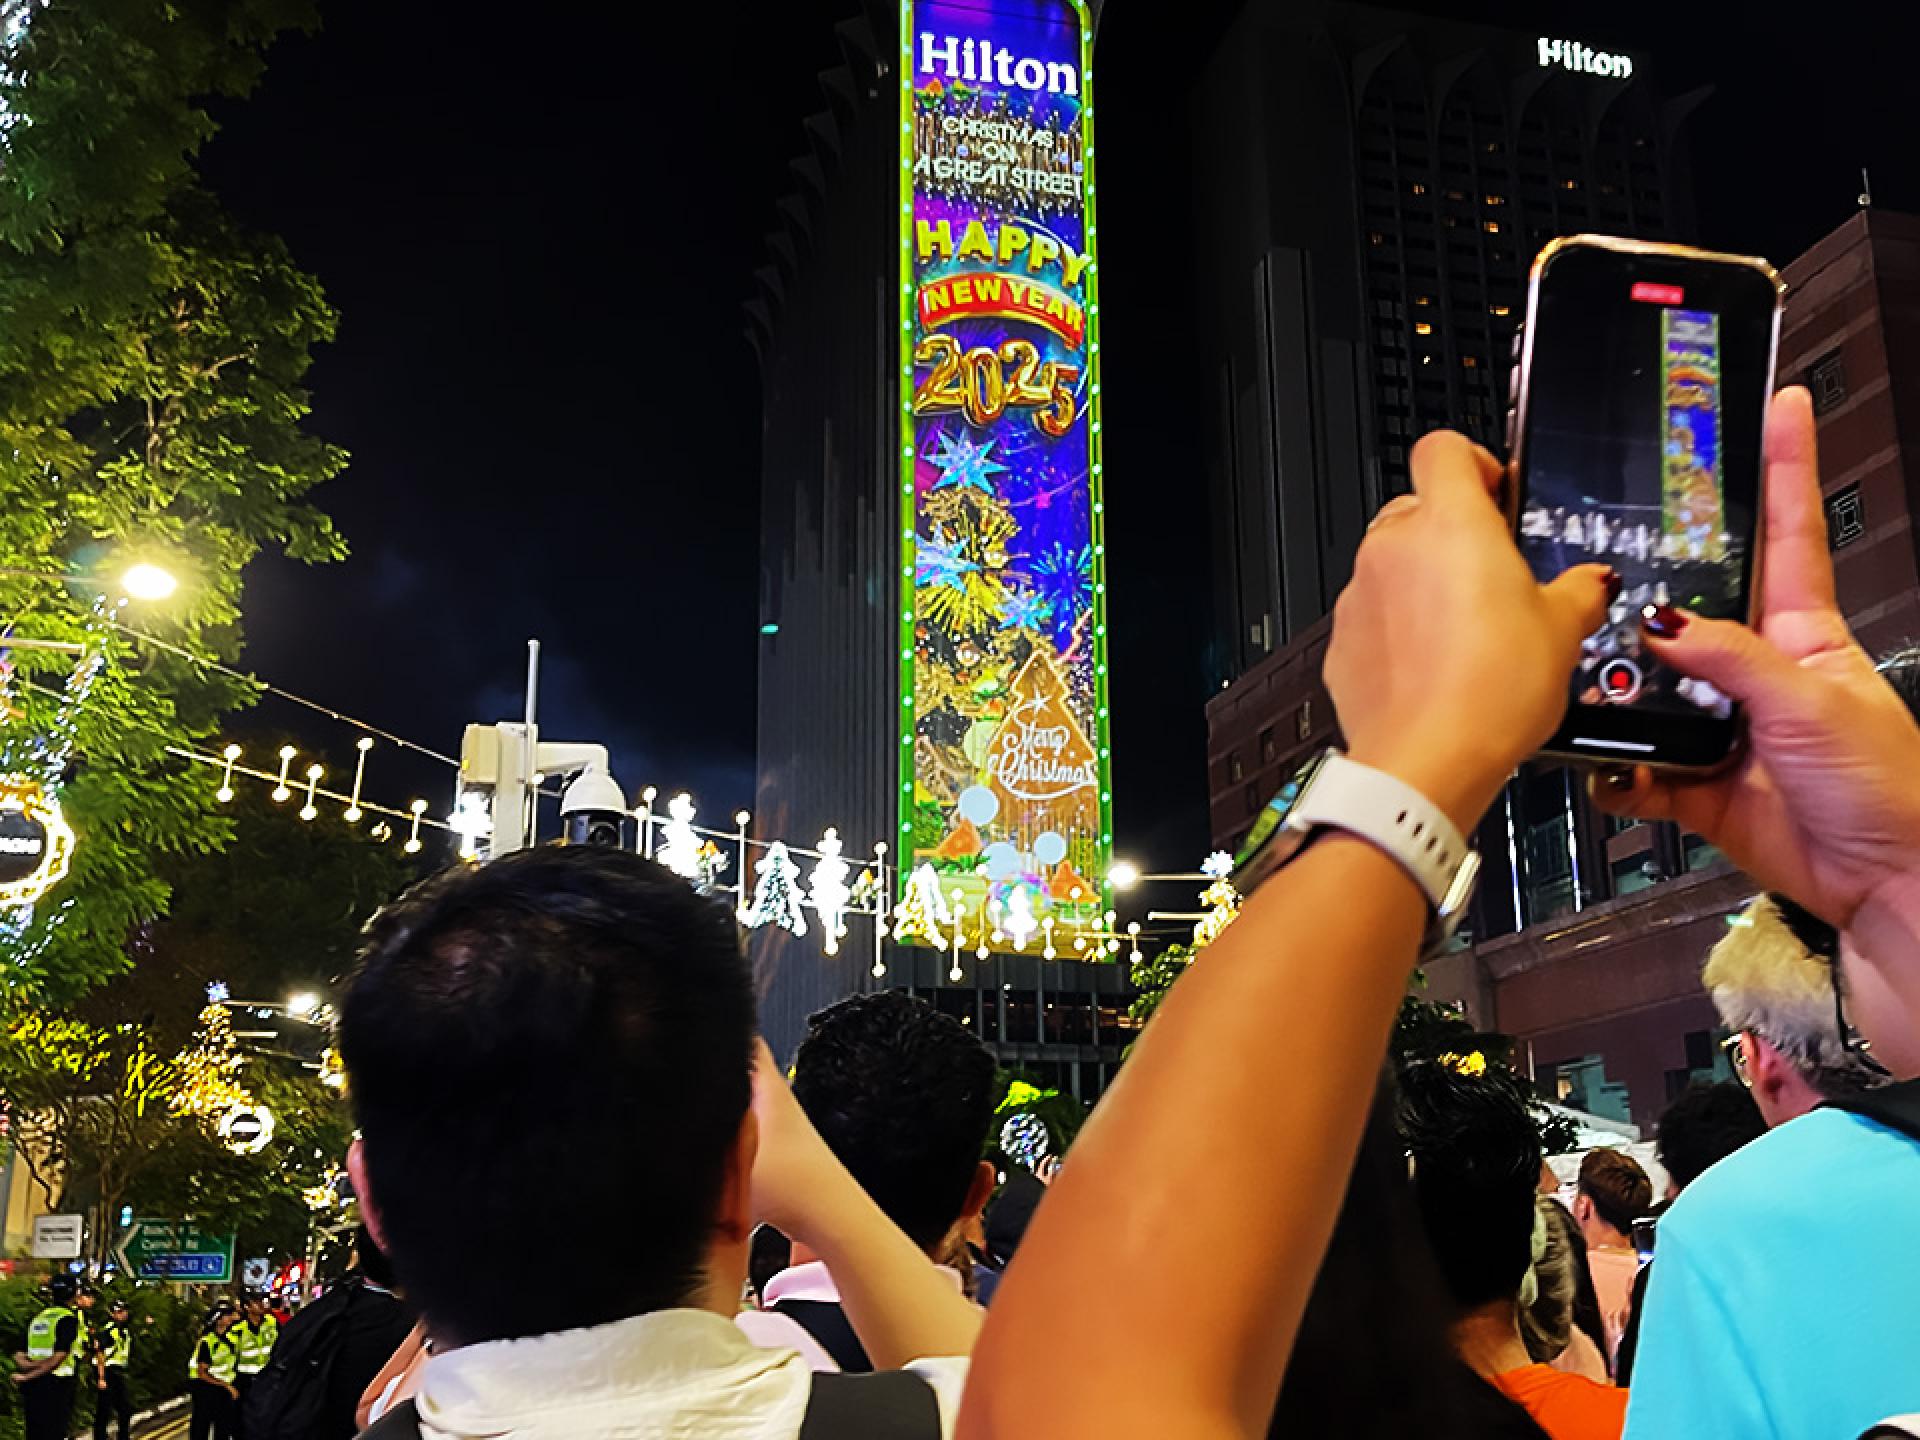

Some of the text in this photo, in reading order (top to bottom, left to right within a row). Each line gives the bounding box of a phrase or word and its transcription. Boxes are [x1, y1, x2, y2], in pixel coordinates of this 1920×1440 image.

[919, 32, 1078, 95] Hilton
[1537, 36, 1632, 78] Hilton
[943, 117, 1054, 149] CHRISTMAS
[981, 142, 1019, 163] ON
[914, 153, 1083, 200] A GREAT STREET
[916, 219, 1092, 287] HAPPY
[927, 278, 1083, 331] NEW YEAR
[914, 333, 1076, 437] 2025
[1003, 701, 1070, 759] Merry
[988, 748, 1098, 800] Christmas
